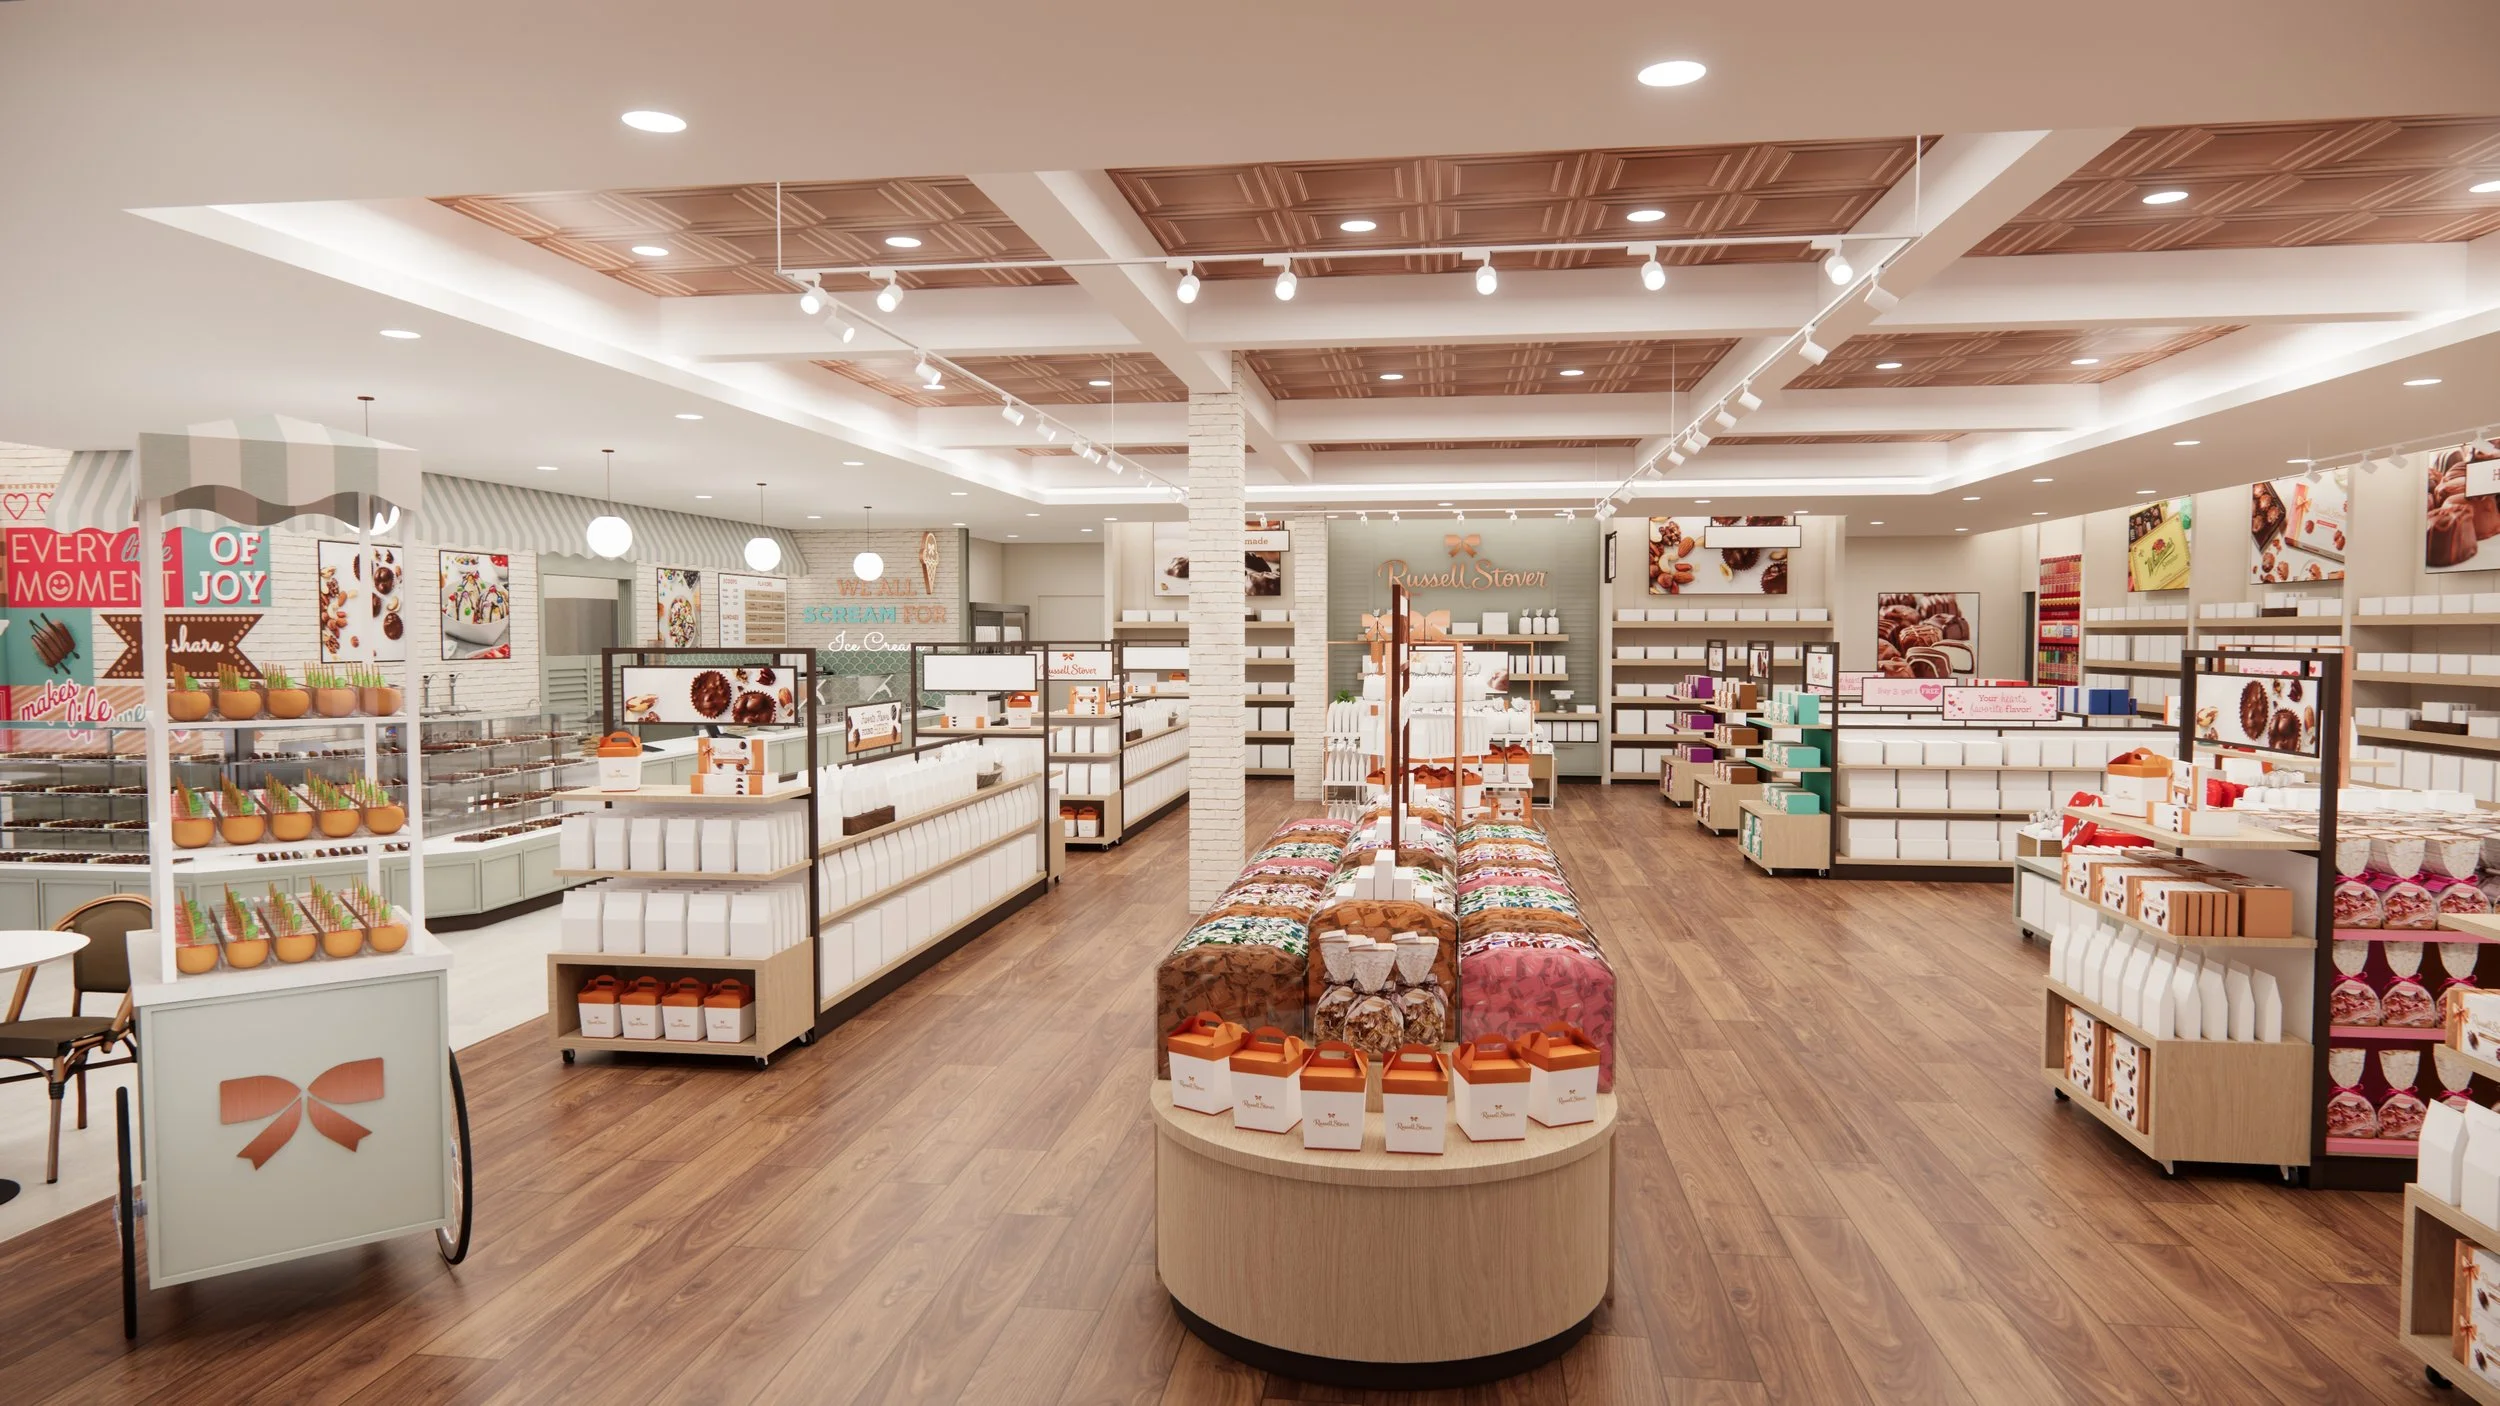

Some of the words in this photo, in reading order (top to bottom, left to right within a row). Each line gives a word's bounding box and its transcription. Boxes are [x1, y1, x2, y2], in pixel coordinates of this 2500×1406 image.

[11, 532, 119, 564] EVERY
[209, 531, 262, 566] OF
[191, 569, 268, 605] JOY
[836, 577, 872, 597] WE
[877, 576, 918, 597] ALL
[1377, 559, 1471, 600] Russell
[1472, 558, 1547, 591] Stover
[802, 604, 897, 624] SCREAM
[903, 604, 946, 624] FOR
[172, 624, 224, 653] share
[828, 630, 861, 652] Ice
[863, 631, 927, 652] Cream
[1071, 663, 1097, 676] Stover
[21, 680, 81, 722] makes
[1920, 687, 1940, 695] FREE
[1978, 694, 1998, 703] Your
[67, 687, 113, 742] life
[2005, 704, 2033, 714] flavor!
